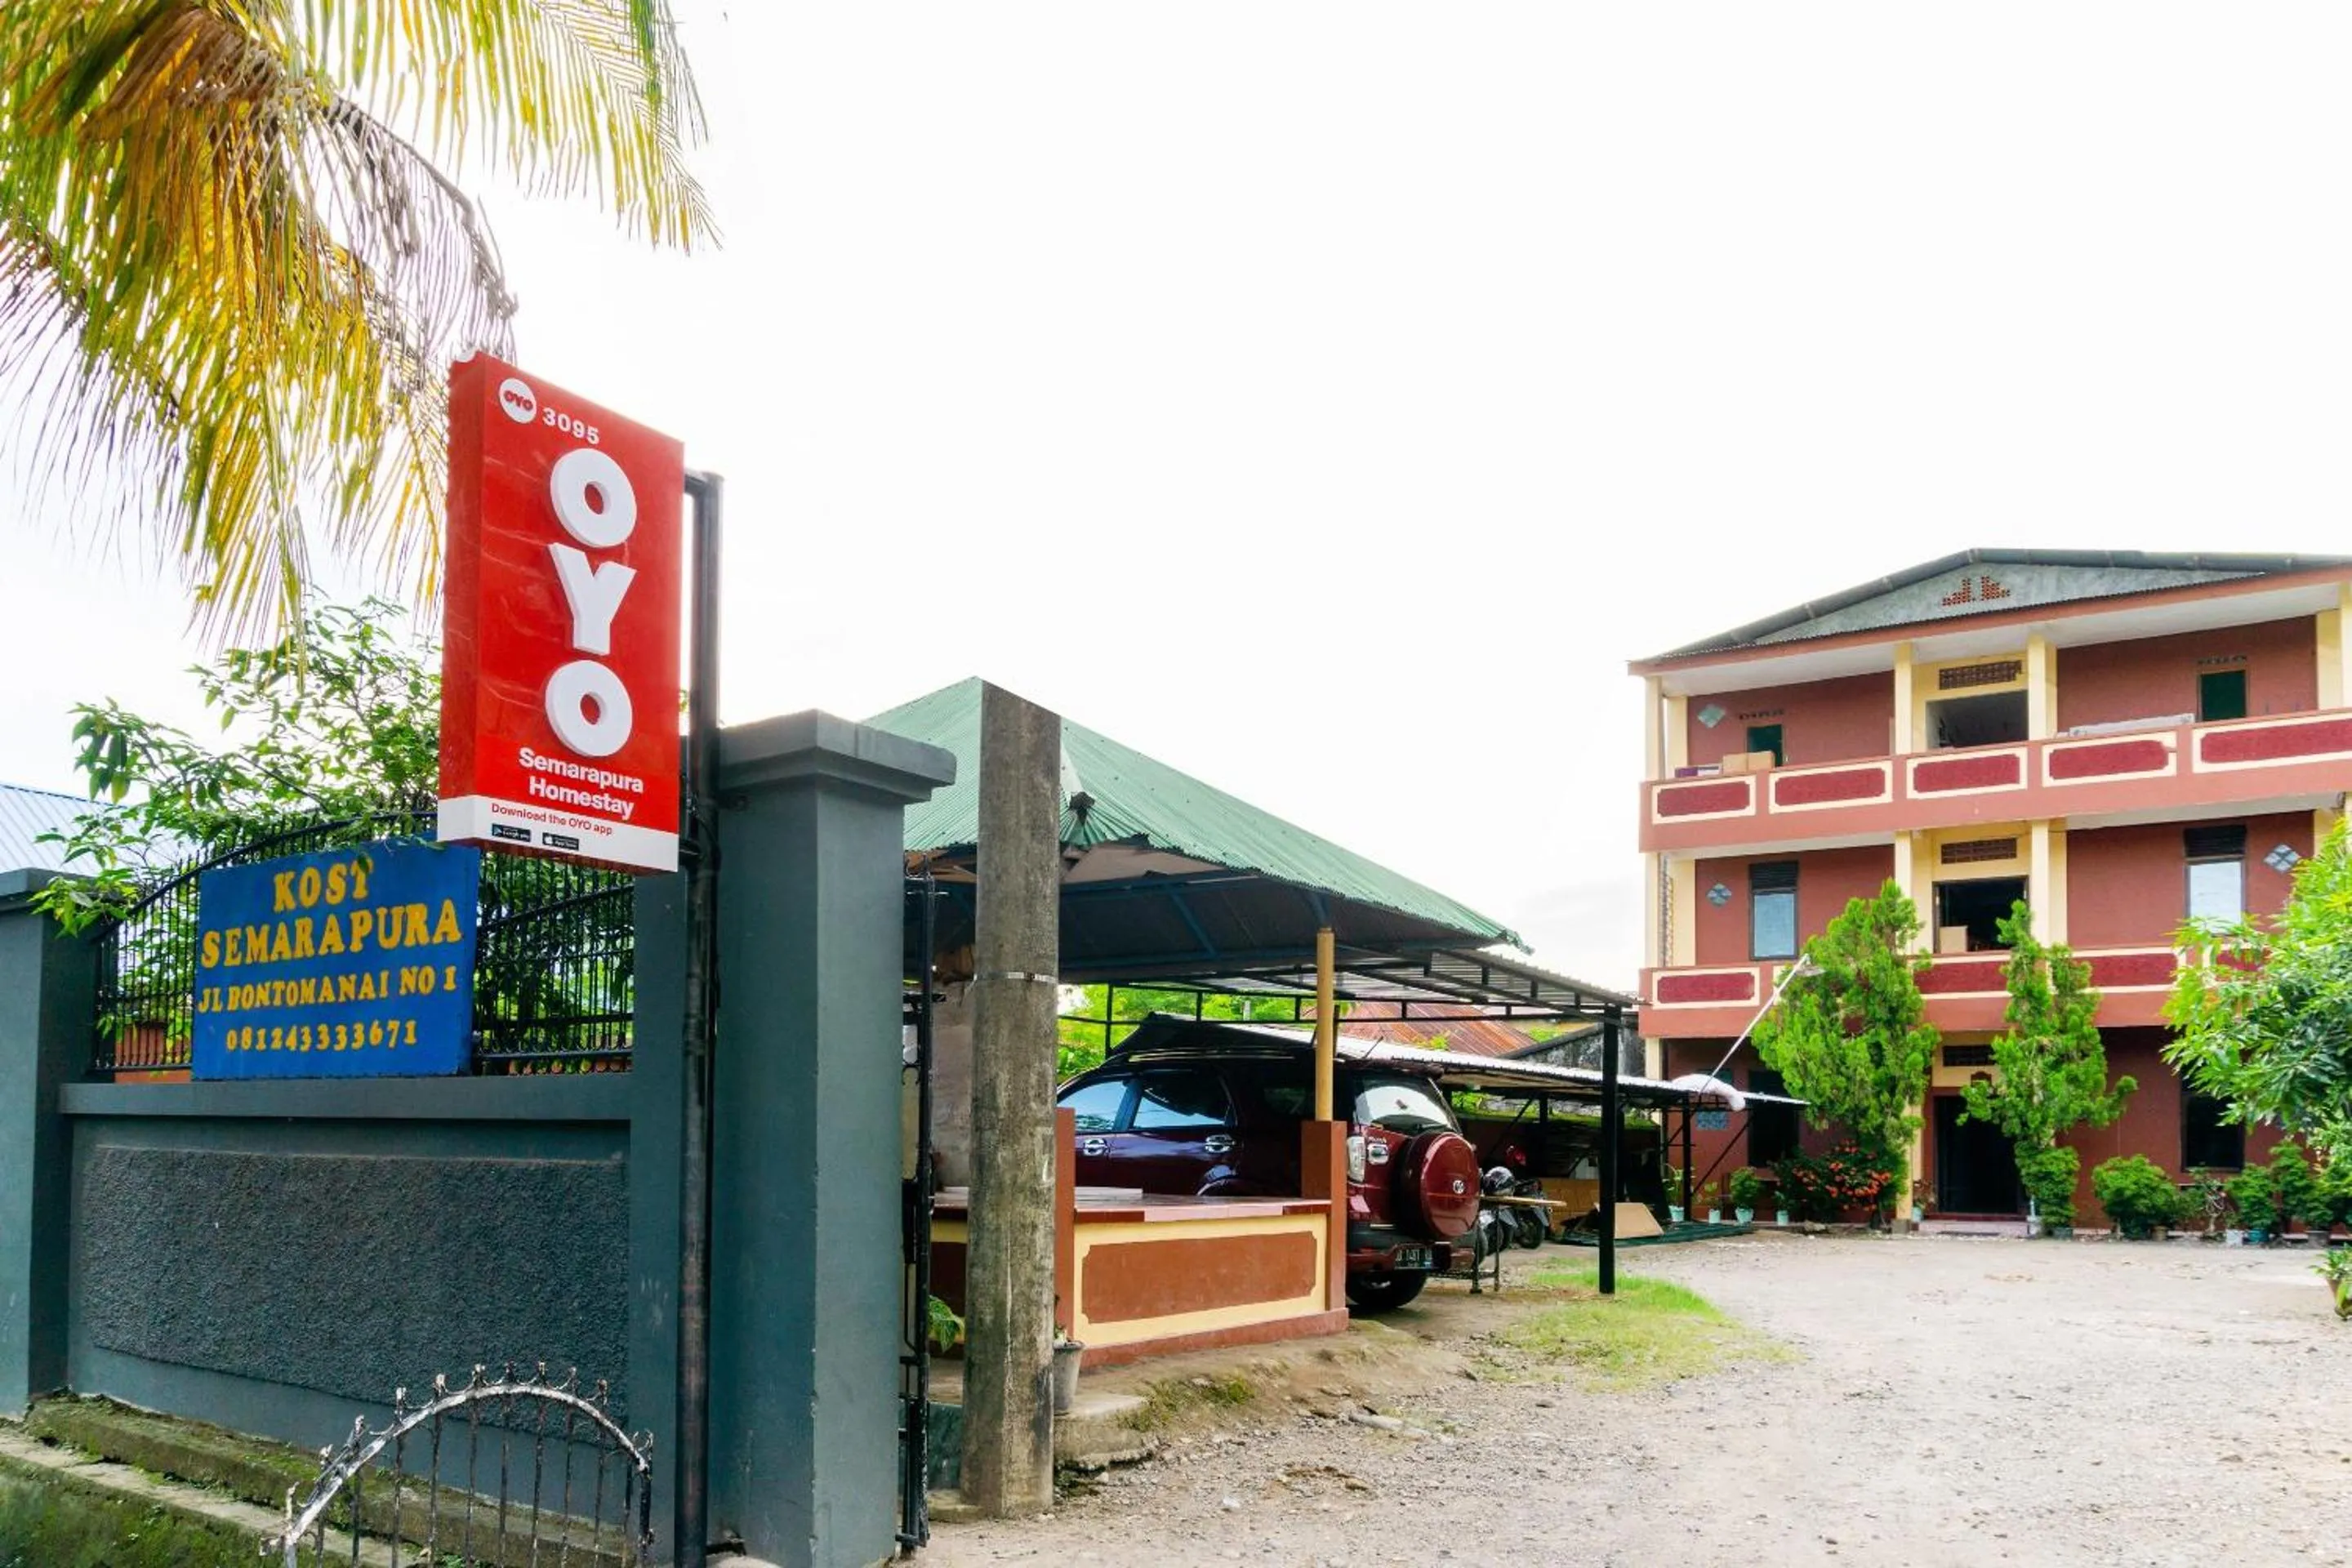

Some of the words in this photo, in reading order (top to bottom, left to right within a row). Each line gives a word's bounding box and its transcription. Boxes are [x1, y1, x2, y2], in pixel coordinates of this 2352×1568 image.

[504, 390, 534, 412] OYO
[542, 407, 599, 444] 3095
[546, 448, 637, 757] OYO
[519, 746, 644, 794] Semarapura
[492, 803, 546, 822] Download
[549, 813, 567, 826] the
[568, 817, 591, 831] OYO
[594, 824, 612, 835] app
[529, 775, 635, 821] Homestay
[274, 854, 373, 913] KOST
[200, 899, 462, 969] SEMARAPURA
[227, 969, 389, 1011] BONTOMANAI
[399, 965, 435, 996] NO
[443, 965, 457, 991] 1
[225, 1019, 417, 1053] 081243333671
